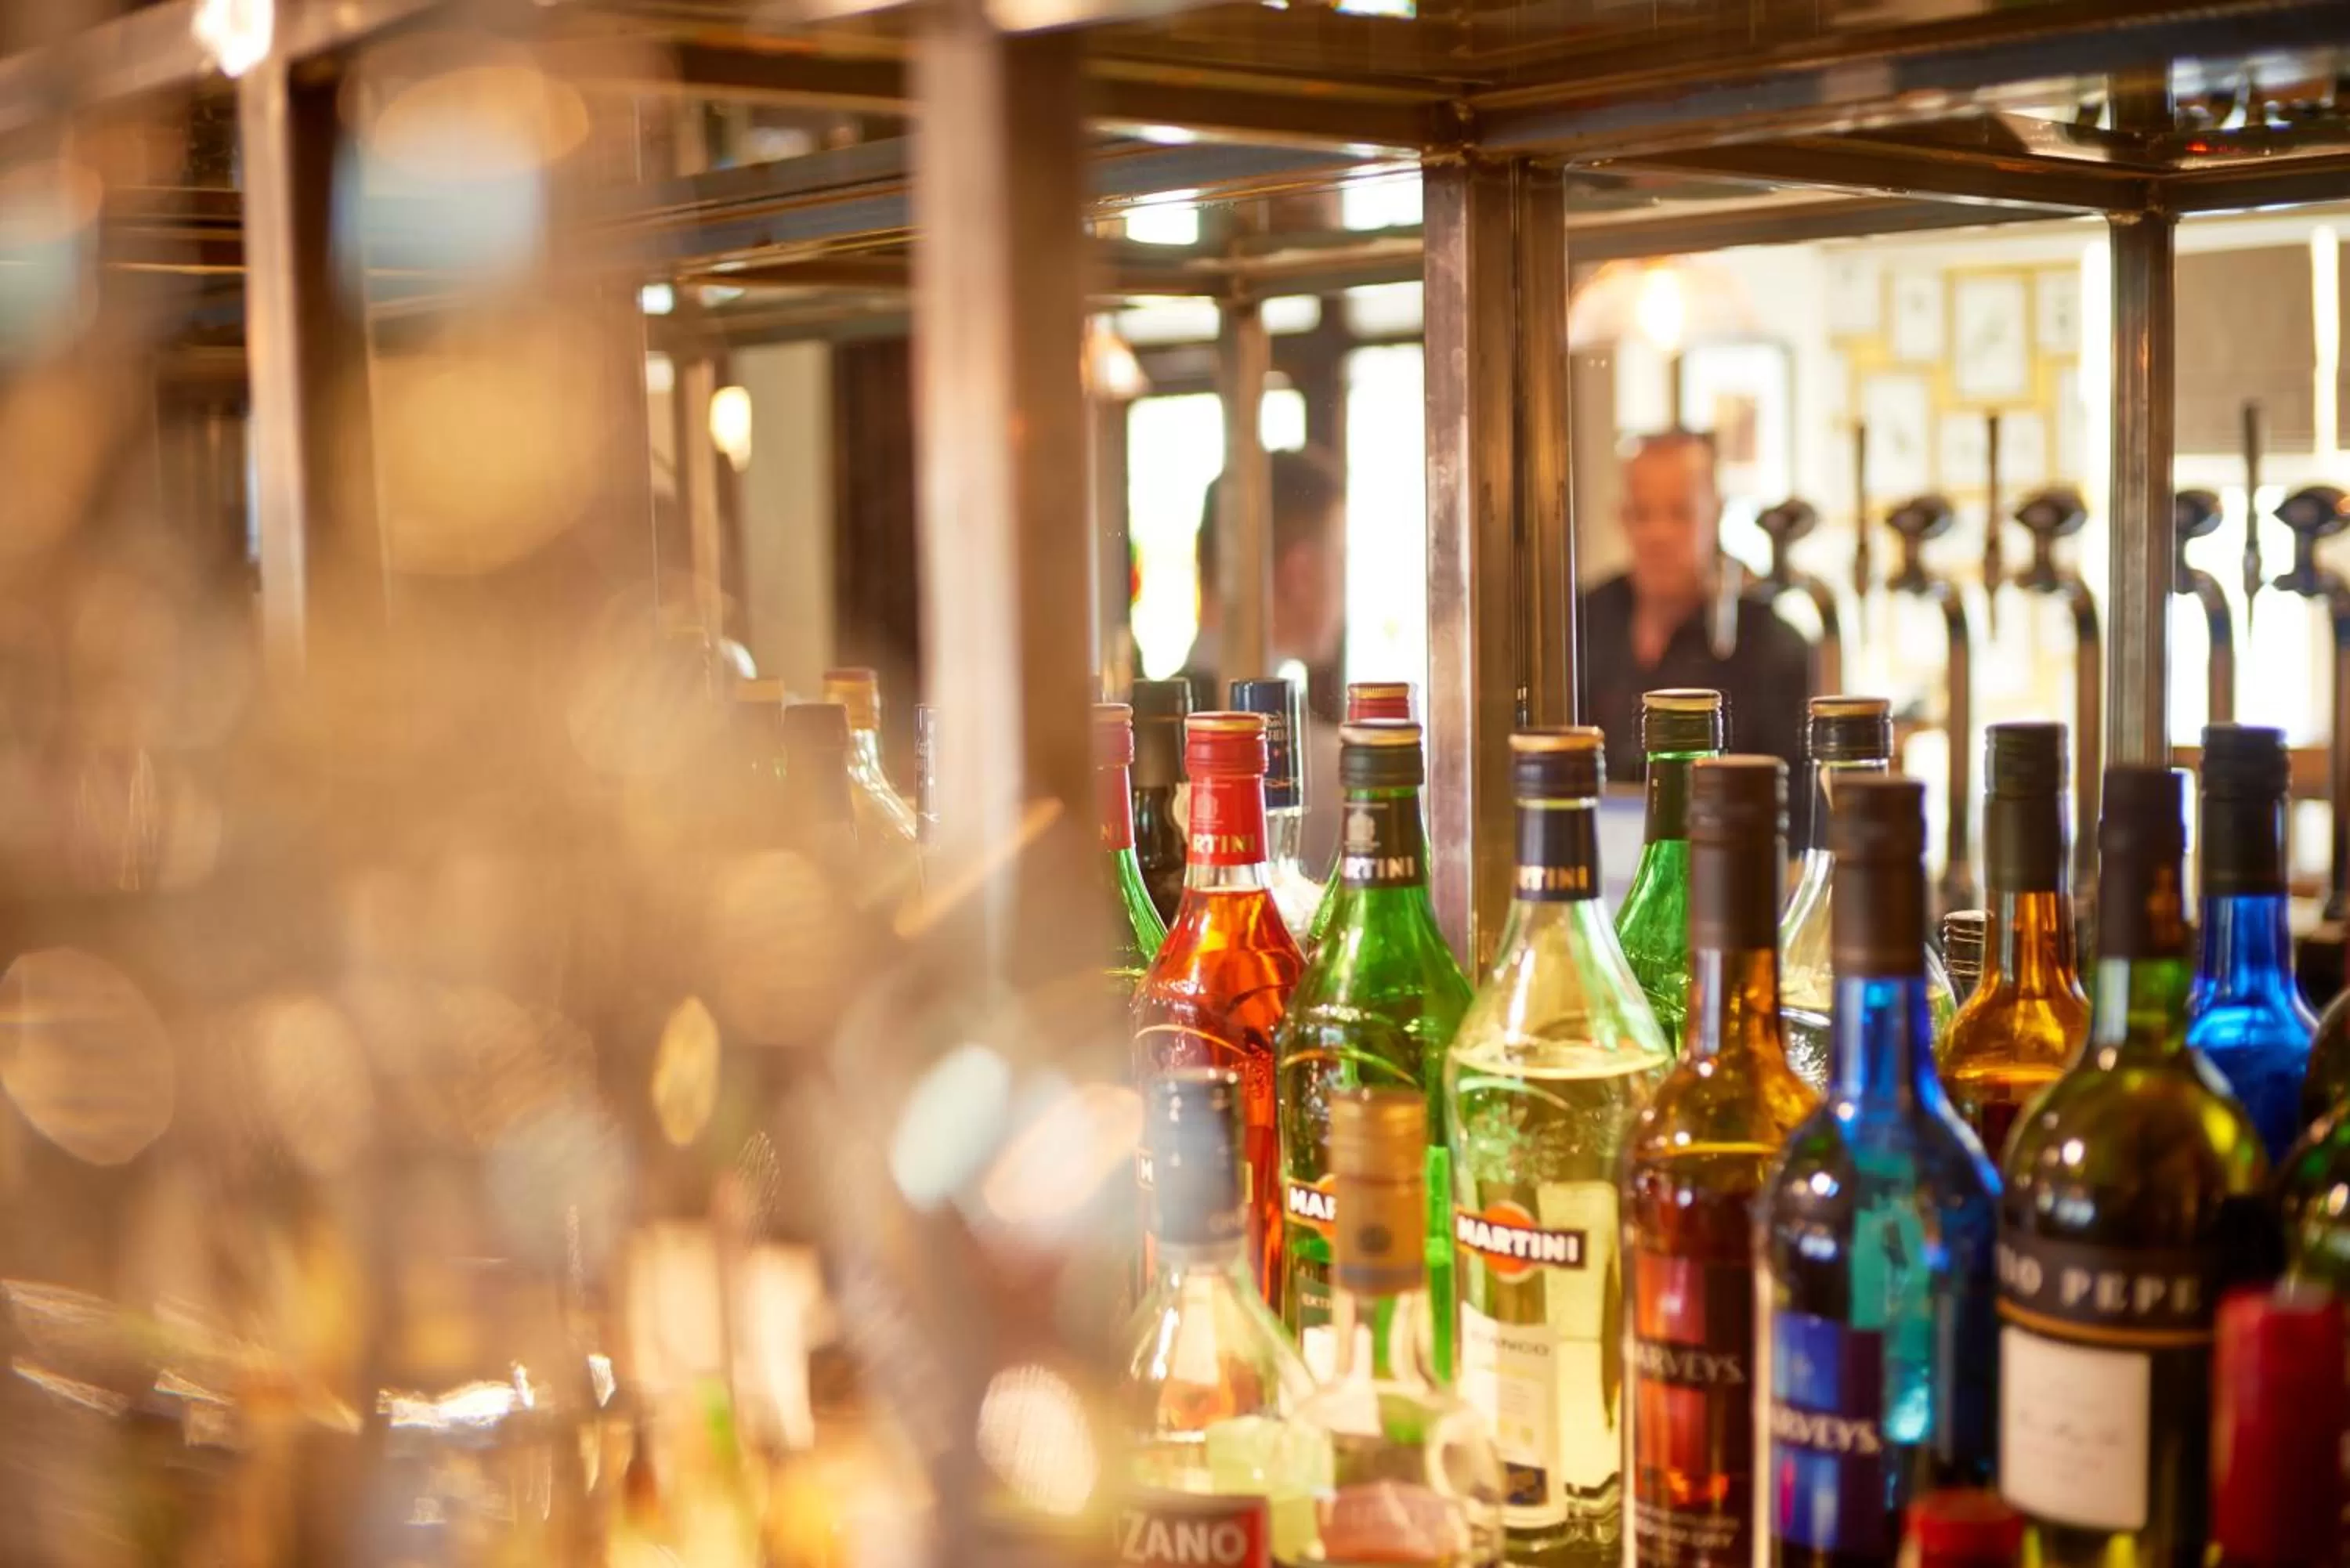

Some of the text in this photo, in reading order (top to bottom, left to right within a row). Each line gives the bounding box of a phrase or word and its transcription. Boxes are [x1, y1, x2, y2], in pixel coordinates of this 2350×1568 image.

[1457, 1215, 1578, 1262] MARTINI
[2060, 1267, 2200, 1314] PEPE
[1122, 1509, 1248, 1565] ZANO
